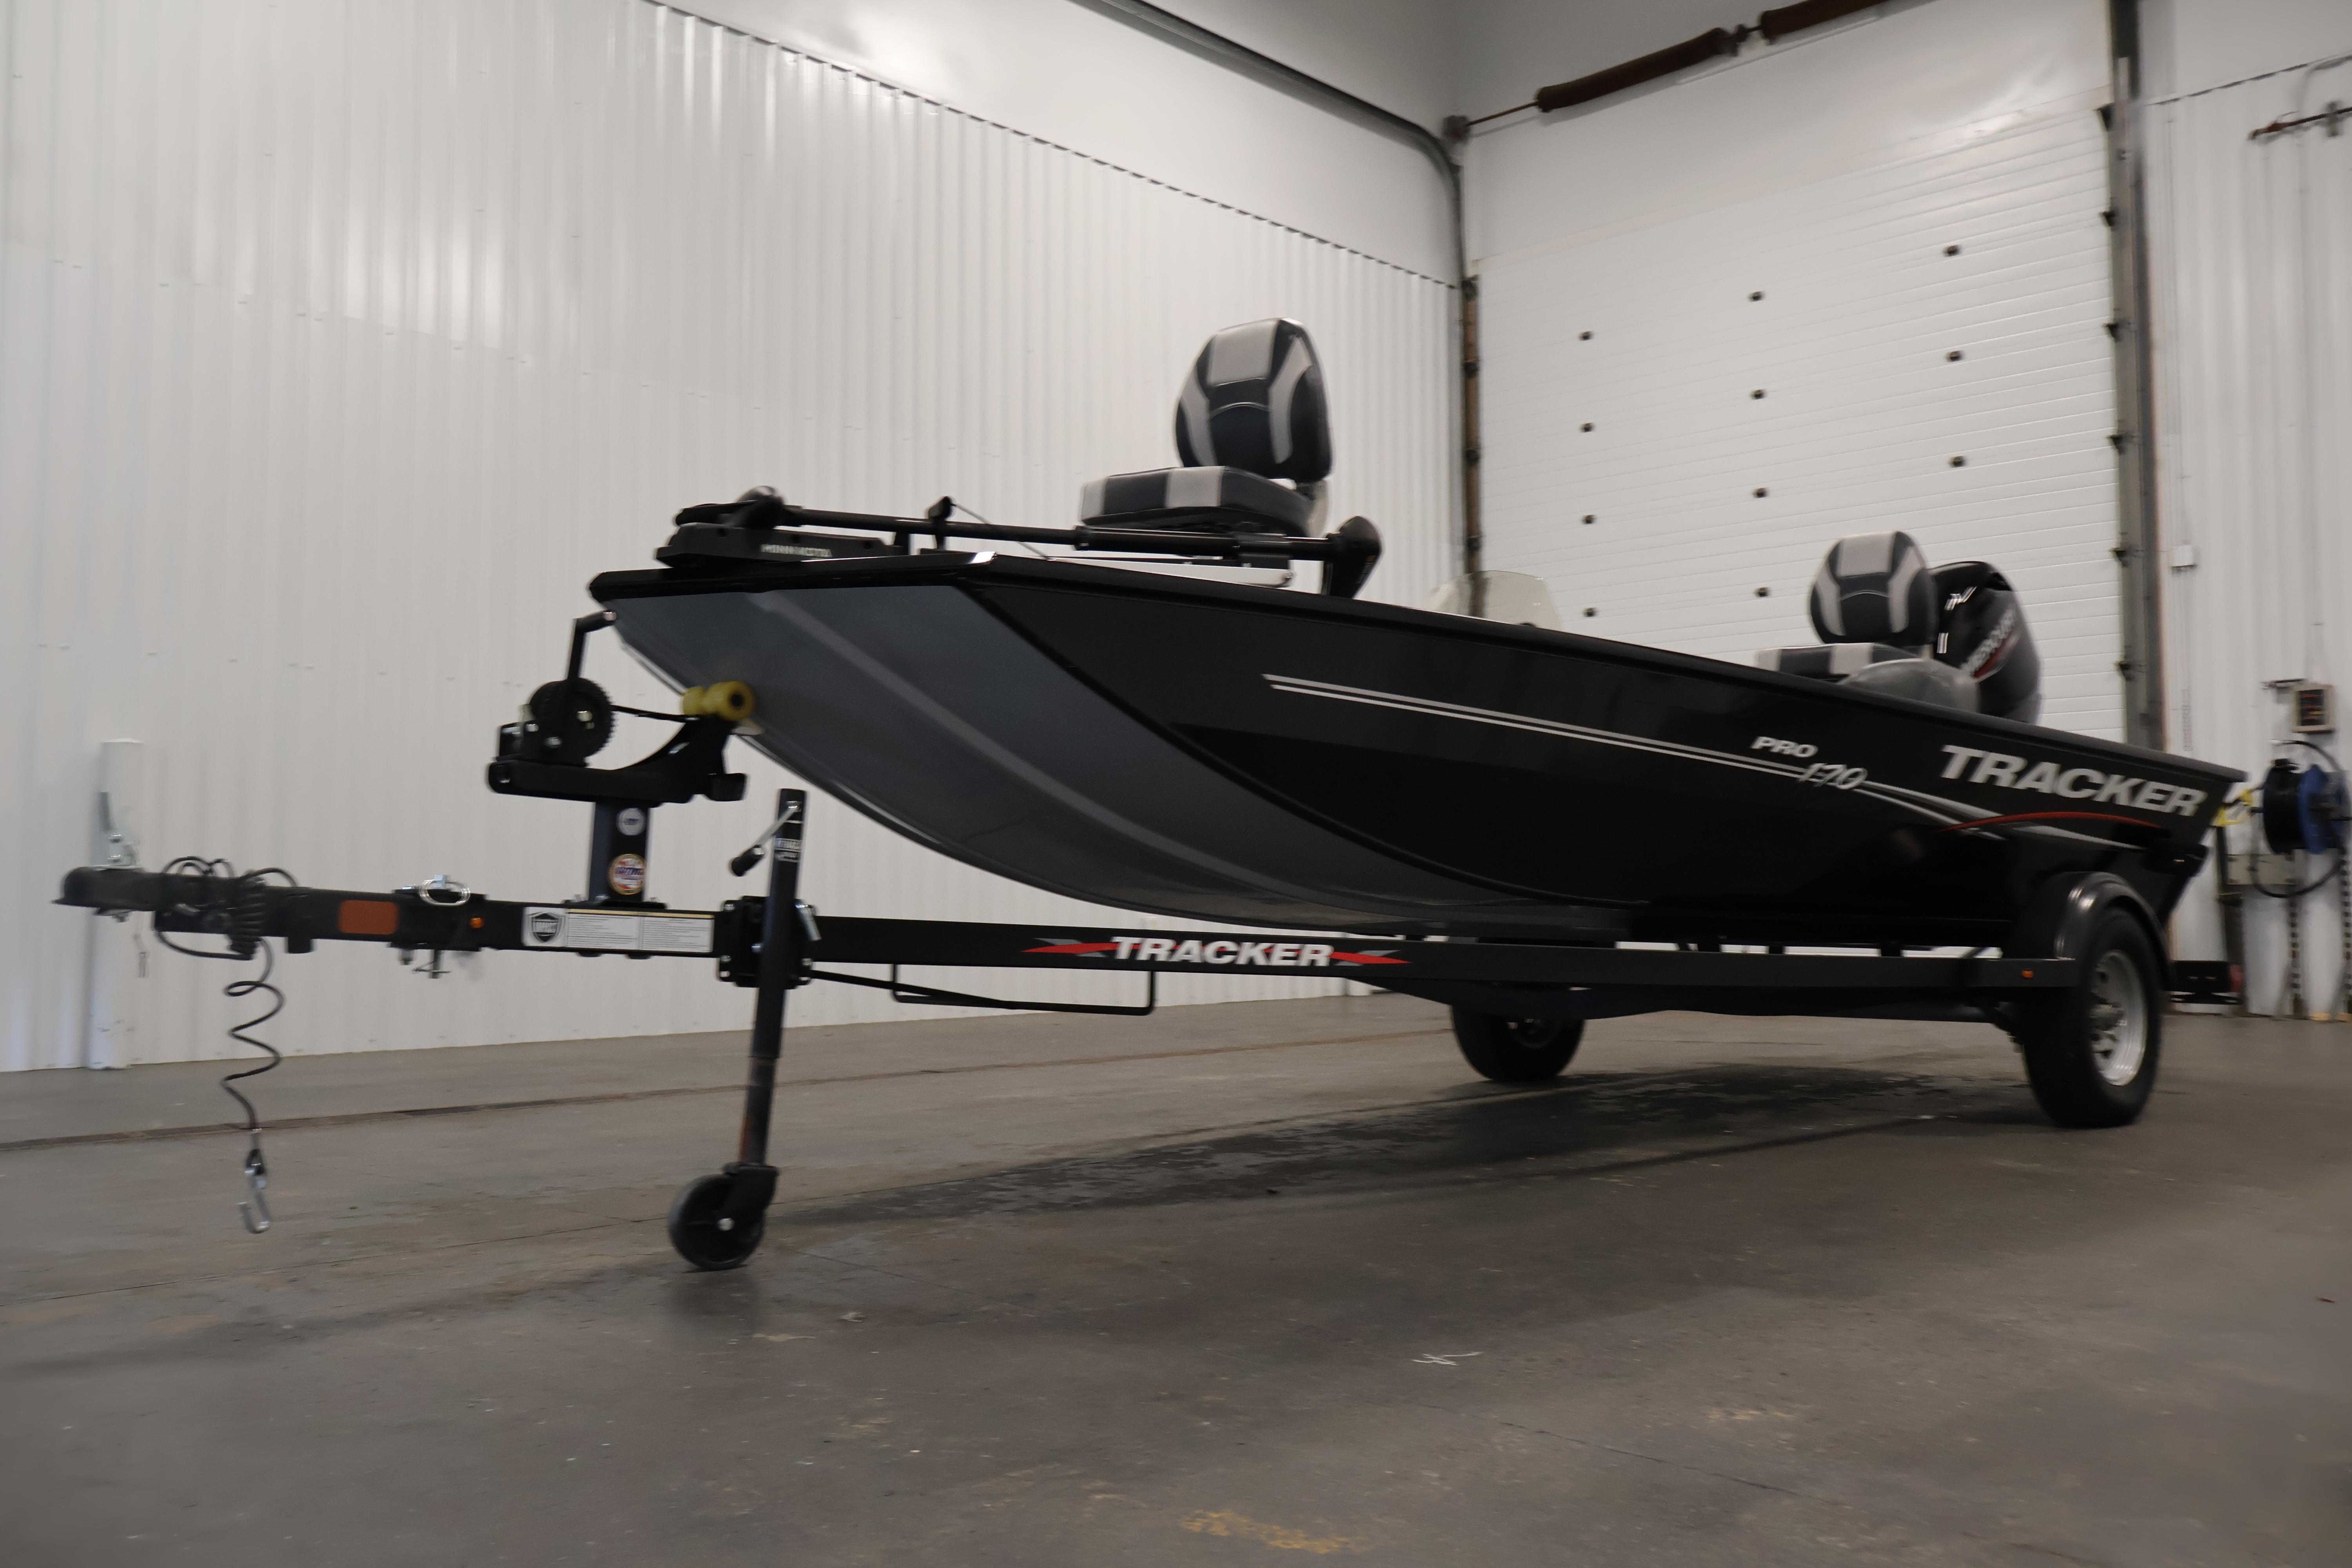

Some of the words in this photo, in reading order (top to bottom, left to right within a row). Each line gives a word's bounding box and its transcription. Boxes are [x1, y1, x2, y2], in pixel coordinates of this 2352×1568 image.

[1751, 737, 1818, 758] PRO
[1940, 744, 2208, 817] TRACKER
[1111, 936, 1334, 966] TRACKER
